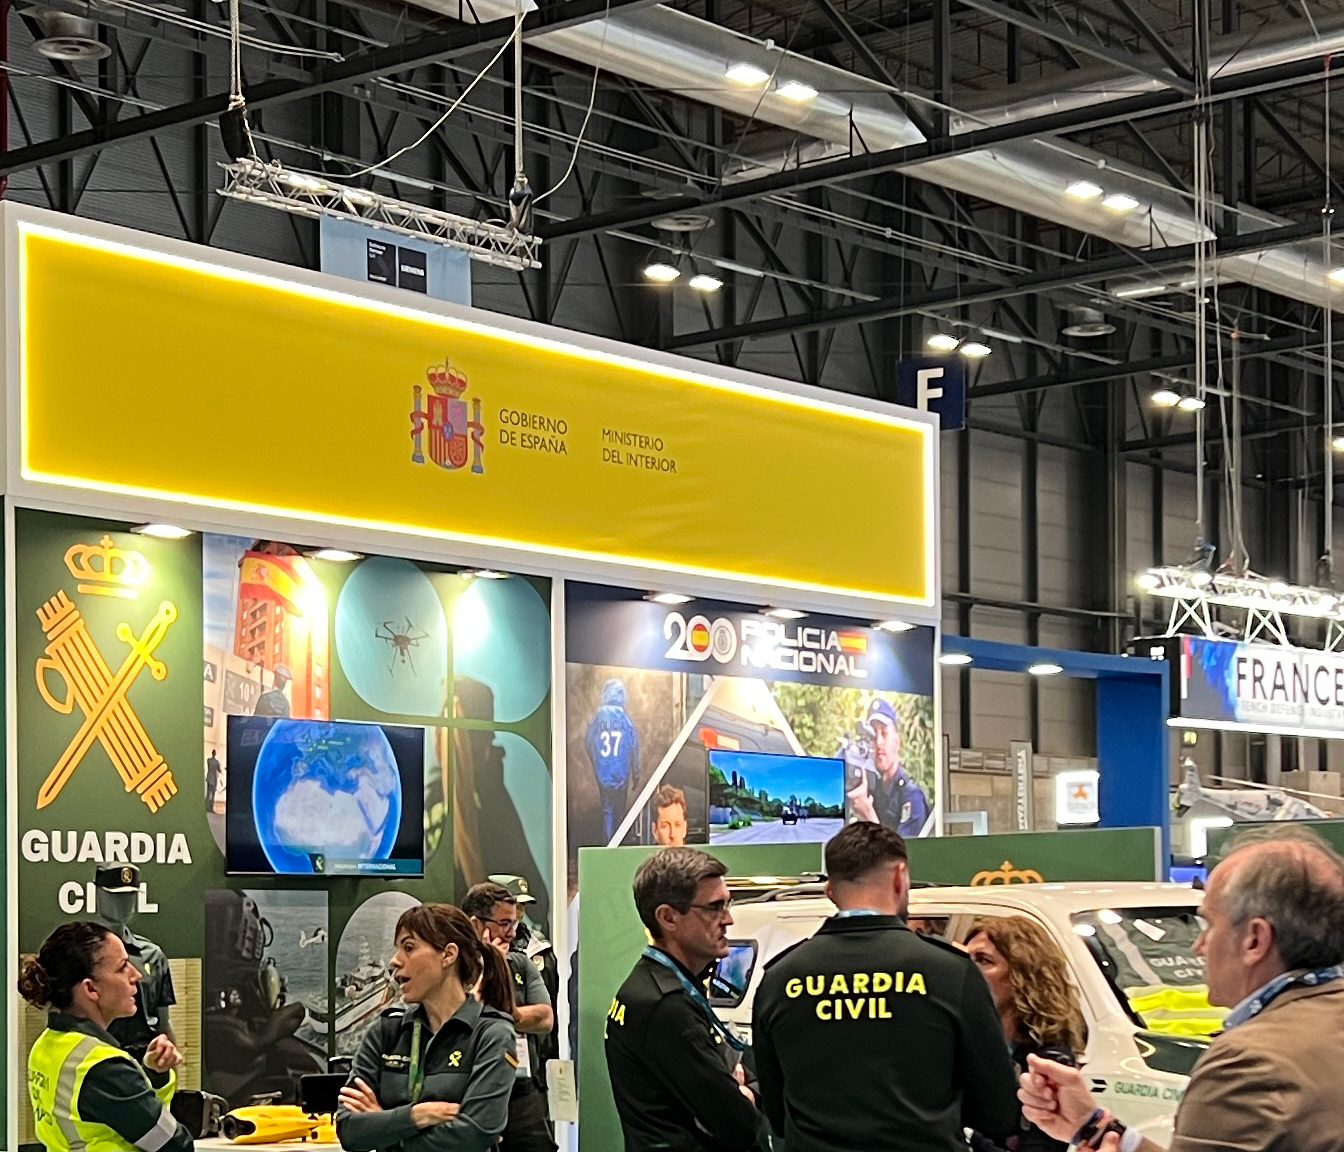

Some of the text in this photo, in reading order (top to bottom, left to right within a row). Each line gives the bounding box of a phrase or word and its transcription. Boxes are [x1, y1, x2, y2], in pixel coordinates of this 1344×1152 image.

[499, 408, 568, 435] GOBIERNO
[499, 429, 568, 456] DE ESPAÑA
[602, 428, 664, 451] MINISTERIO
[602, 448, 677, 473] DEL INTERIOR
[741, 645, 867, 678] NACIONAL
[1236, 657, 1344, 706] FRANCE
[600, 731, 622, 757] 37
[21, 829, 192, 864] GUARDIA
[58, 881, 159, 914] CIL
[1150, 955, 1207, 967] GUARD
[1174, 968, 1205, 979] CIV
[785, 971, 928, 998] GUARDIA
[815, 998, 893, 1021] CIVIL
[1114, 1081, 1158, 1097] GUARDIA
[1162, 1087, 1186, 1101] CIV
